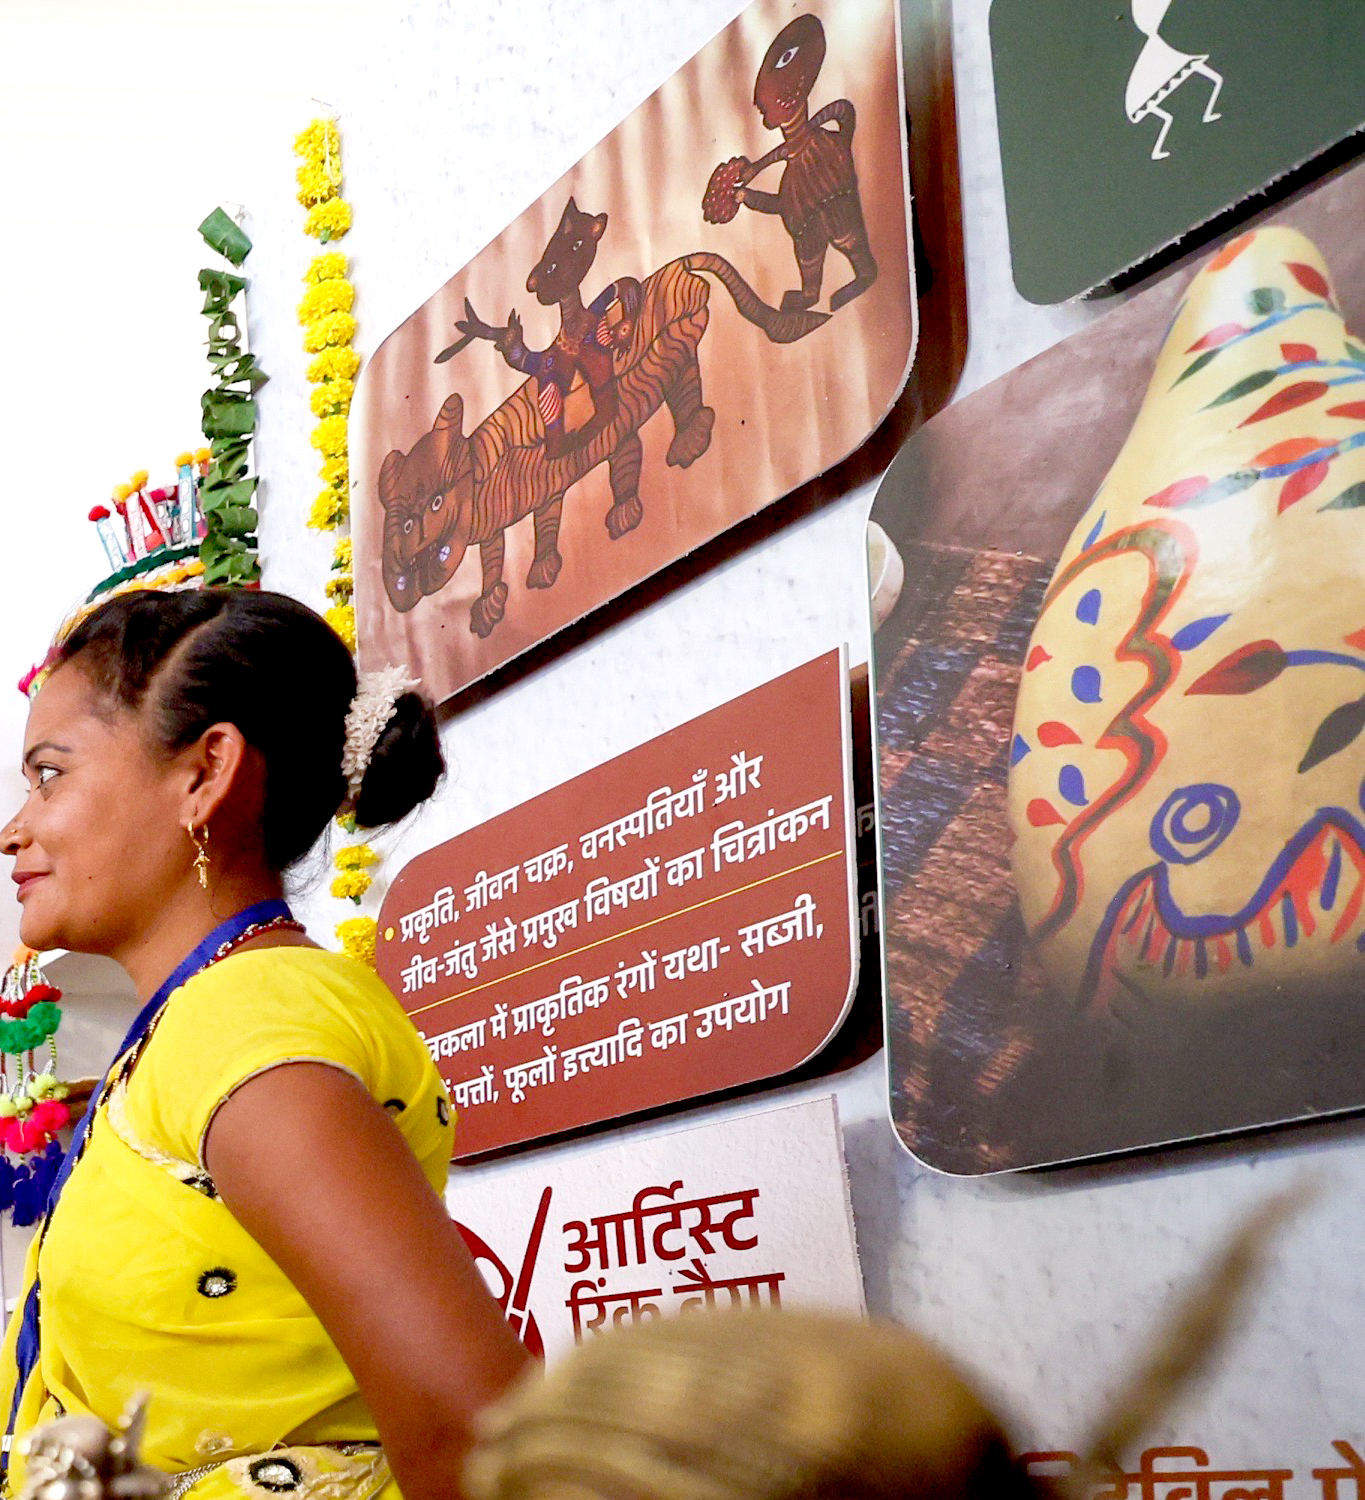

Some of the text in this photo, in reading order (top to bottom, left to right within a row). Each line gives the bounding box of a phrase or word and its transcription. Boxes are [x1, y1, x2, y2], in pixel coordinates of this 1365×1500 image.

[399, 750, 763, 944] प्रकृति, जीवन चक्र, वनस्पतियाँ और
[400, 940, 478, 994] जीव-जंतु
[480, 916, 517, 961] जैसे
[521, 899, 579, 949] प्रमुख
[583, 856, 660, 922] विषयों
[665, 847, 705, 886] का
[710, 795, 833, 872] चित्रांकन
[490, 1003, 508, 1039] में
[511, 975, 610, 1037] प्राकृतिक
[614, 950, 657, 999] रंगों
[662, 937, 731, 980] यथा-
[738, 893, 824, 957] सब्जी,
[503, 1045, 557, 1104] फूलों
[649, 1013, 688, 1049] का
[693, 979, 791, 1039] उपयोग
[563, 1180, 759, 1273] आर्टिस्ट
